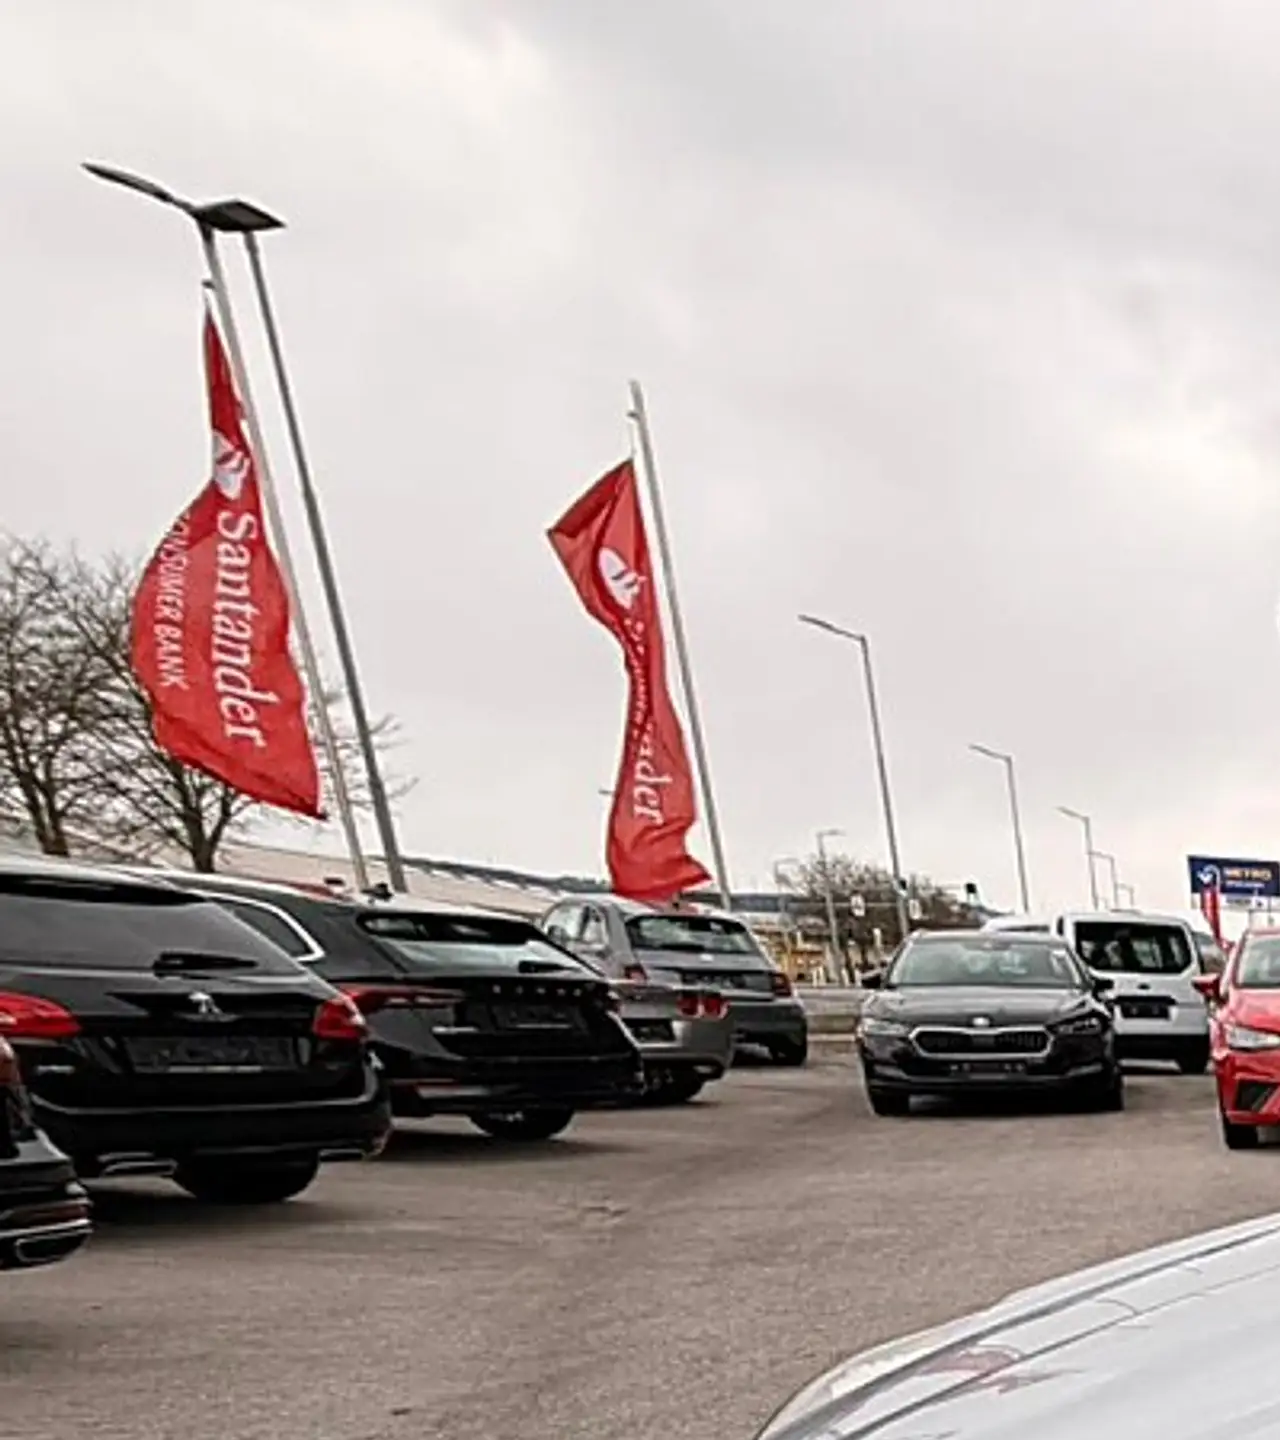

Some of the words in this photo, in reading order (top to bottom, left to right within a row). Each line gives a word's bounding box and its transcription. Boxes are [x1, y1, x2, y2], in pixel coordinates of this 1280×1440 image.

[153, 511, 192, 622] ONSUMER
[153, 622, 191, 691] BANK
[211, 511, 281, 748] Santander
